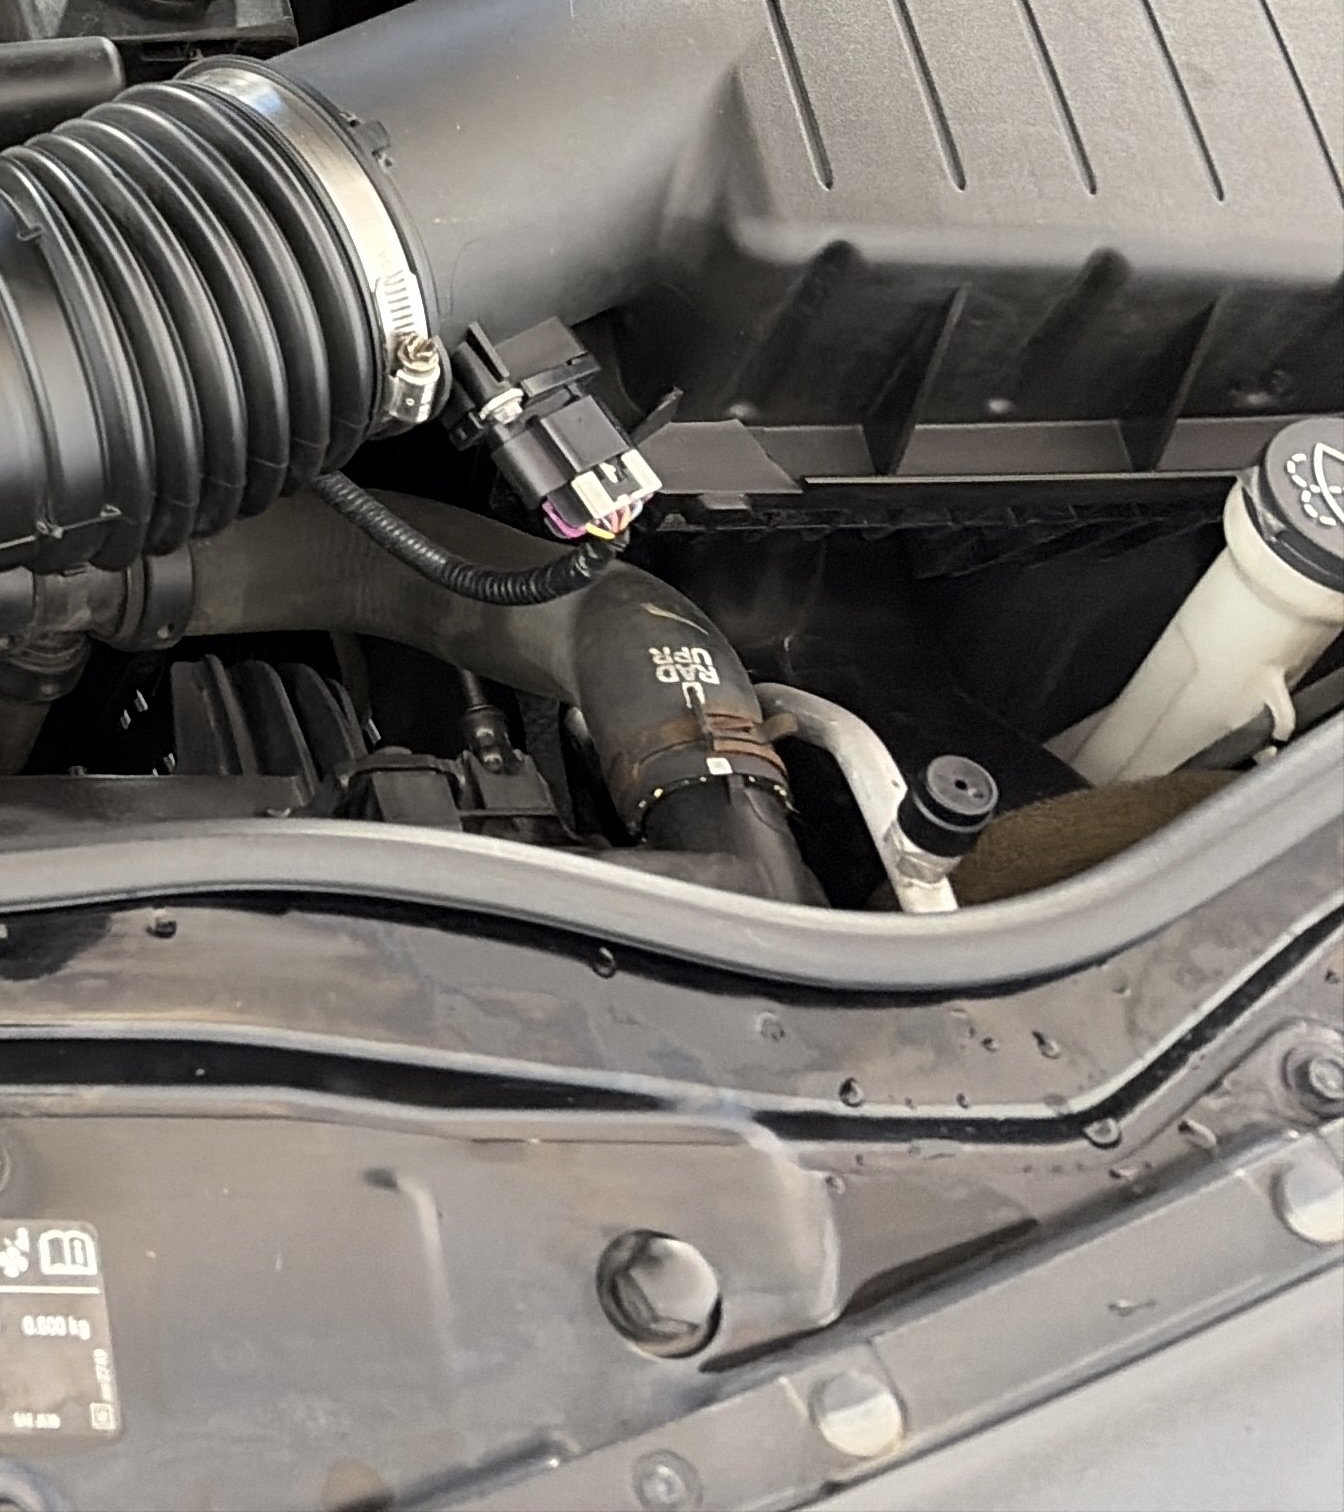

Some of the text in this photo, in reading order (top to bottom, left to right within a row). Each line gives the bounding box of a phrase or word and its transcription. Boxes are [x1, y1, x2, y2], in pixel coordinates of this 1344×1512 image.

[649, 646, 714, 667] UPR
[656, 664, 720, 684] RAD
[69, 1315, 91, 1340] kg
